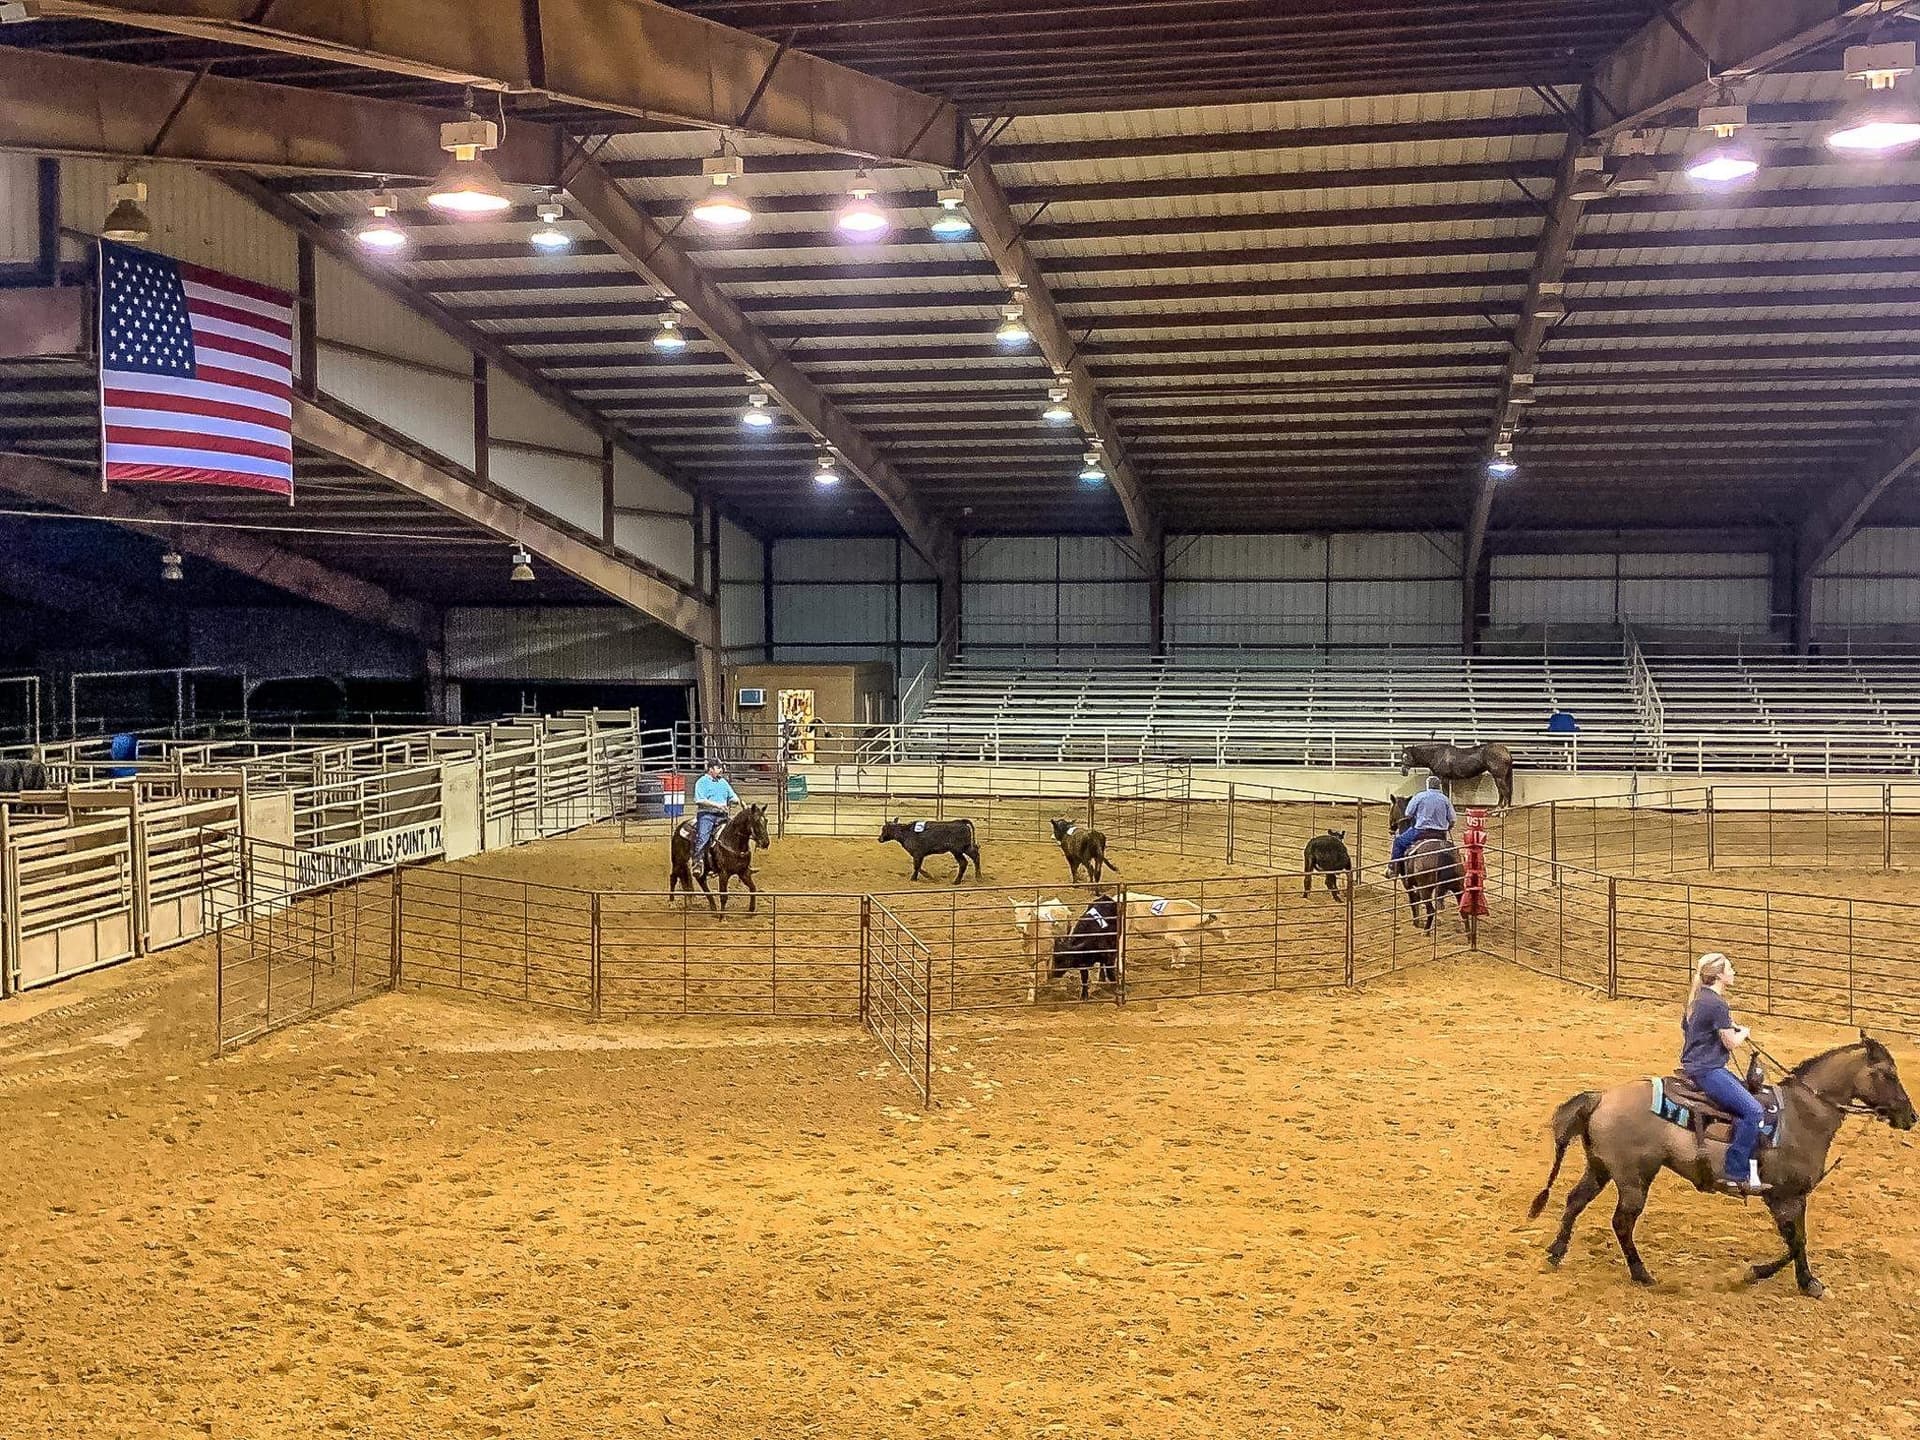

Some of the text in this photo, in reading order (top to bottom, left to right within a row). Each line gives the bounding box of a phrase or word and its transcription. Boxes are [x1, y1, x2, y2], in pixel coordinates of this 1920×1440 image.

[296, 825, 441, 890] AUSTIN ARENA WILLS POINT, TX
